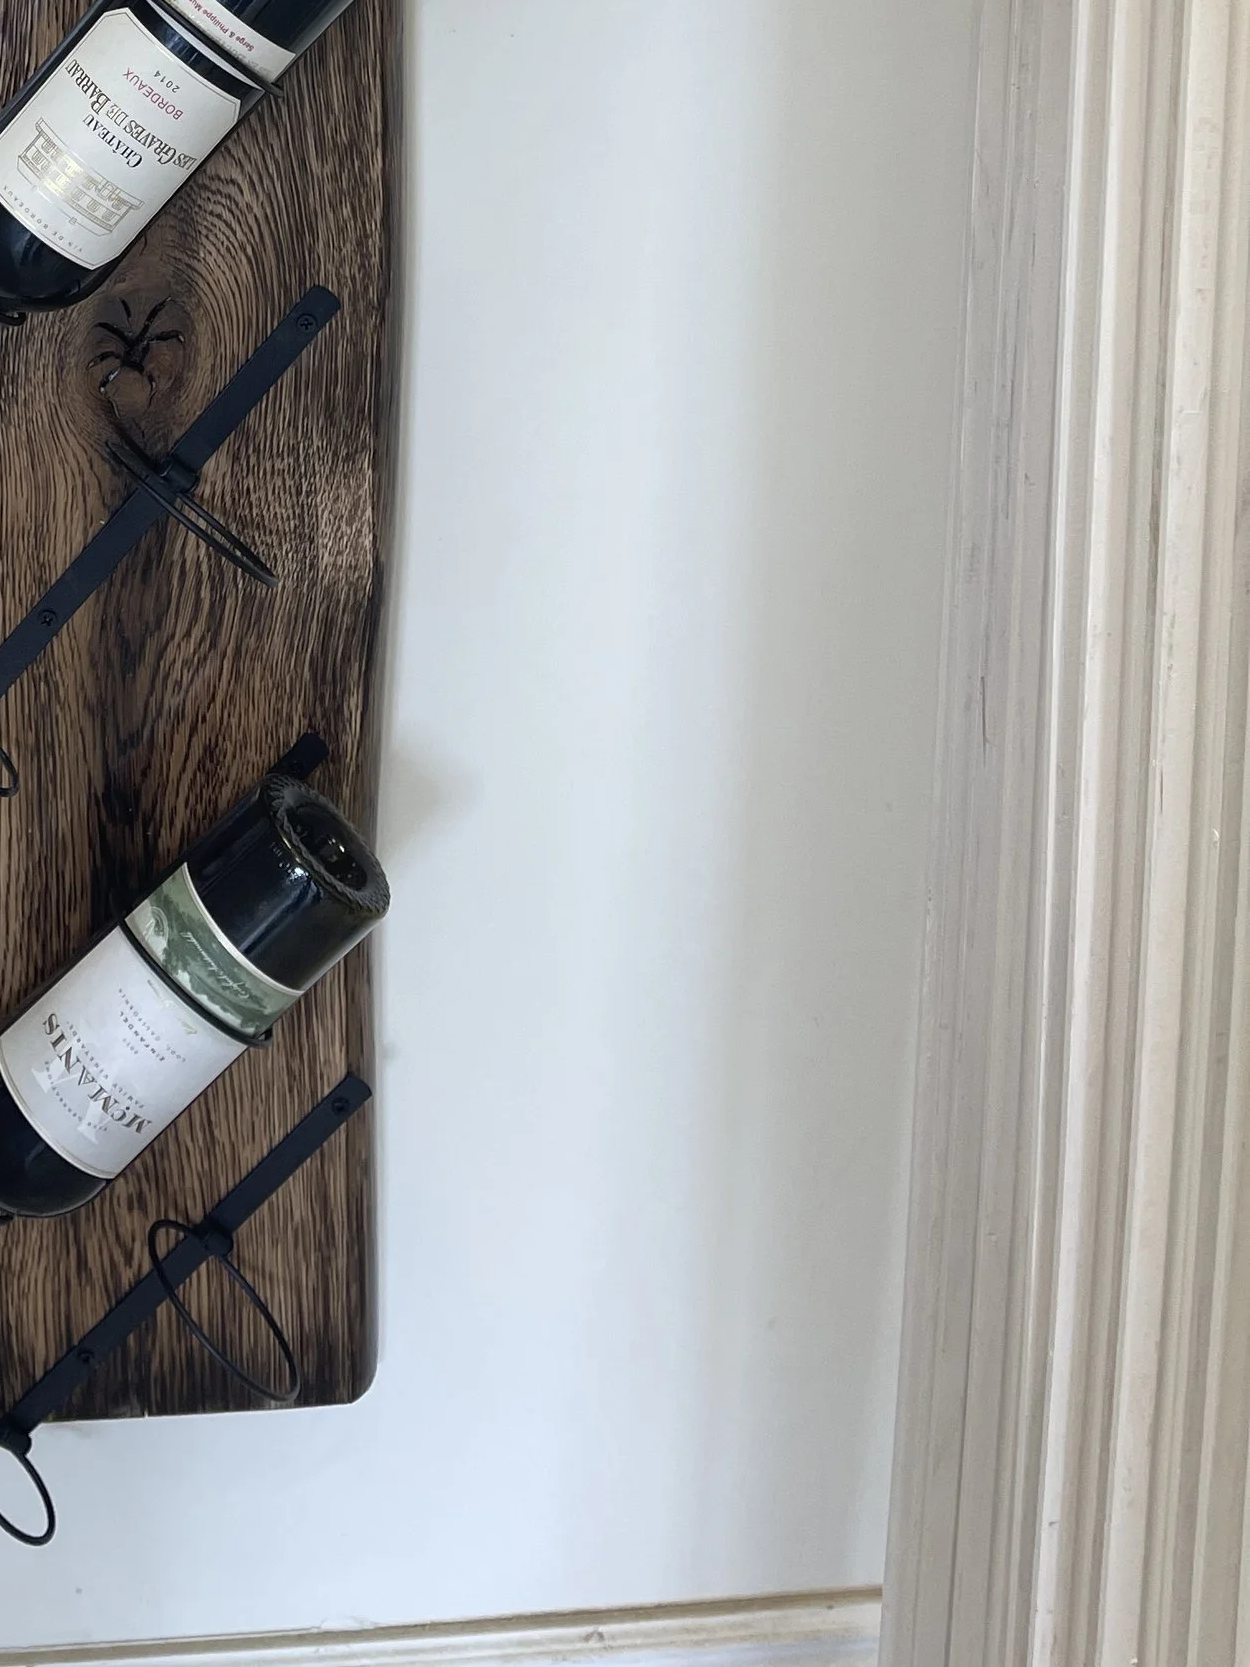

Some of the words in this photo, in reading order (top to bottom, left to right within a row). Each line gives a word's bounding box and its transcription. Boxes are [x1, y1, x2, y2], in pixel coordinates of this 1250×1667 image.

[200, 7, 229, 33] Philippe
[64, 57, 111, 115] BARRAU
[122, 66, 183, 120] BORDEAUX
[153, 69, 180, 93] 2014
[104, 102, 128, 126] DE
[81, 112, 144, 170] CHÂTEAU
[122, 118, 178, 167] GRAVES
[171, 151, 197, 170] LES
[118, 1010, 165, 1062] ZINFANDEL
